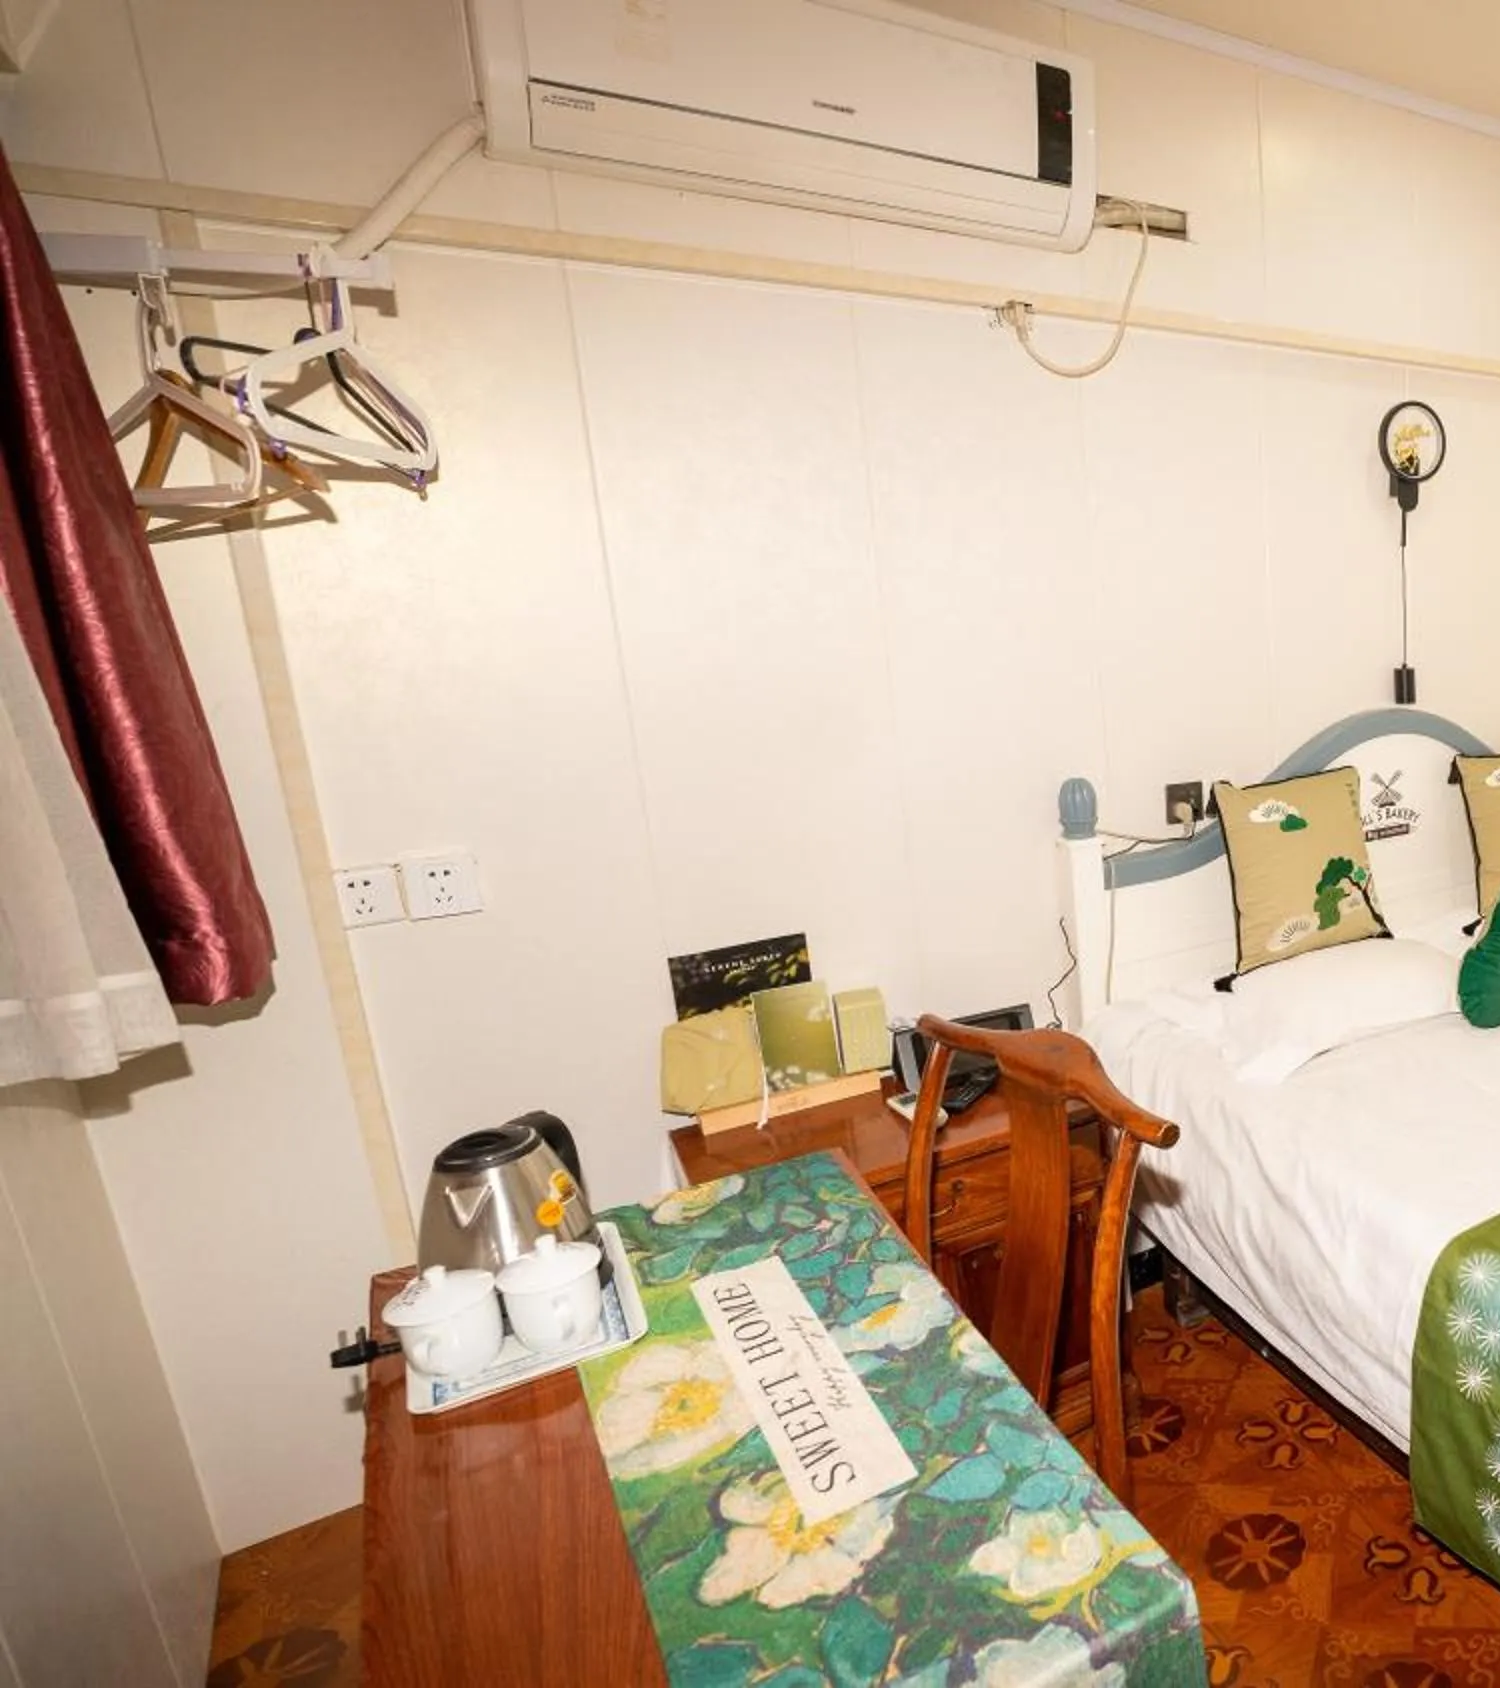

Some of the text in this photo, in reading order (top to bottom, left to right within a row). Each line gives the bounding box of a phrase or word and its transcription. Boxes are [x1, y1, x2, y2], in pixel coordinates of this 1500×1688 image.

[1386, 807, 1421, 823] BAKERY
[713, 1282, 857, 1494] SWEET HOME
